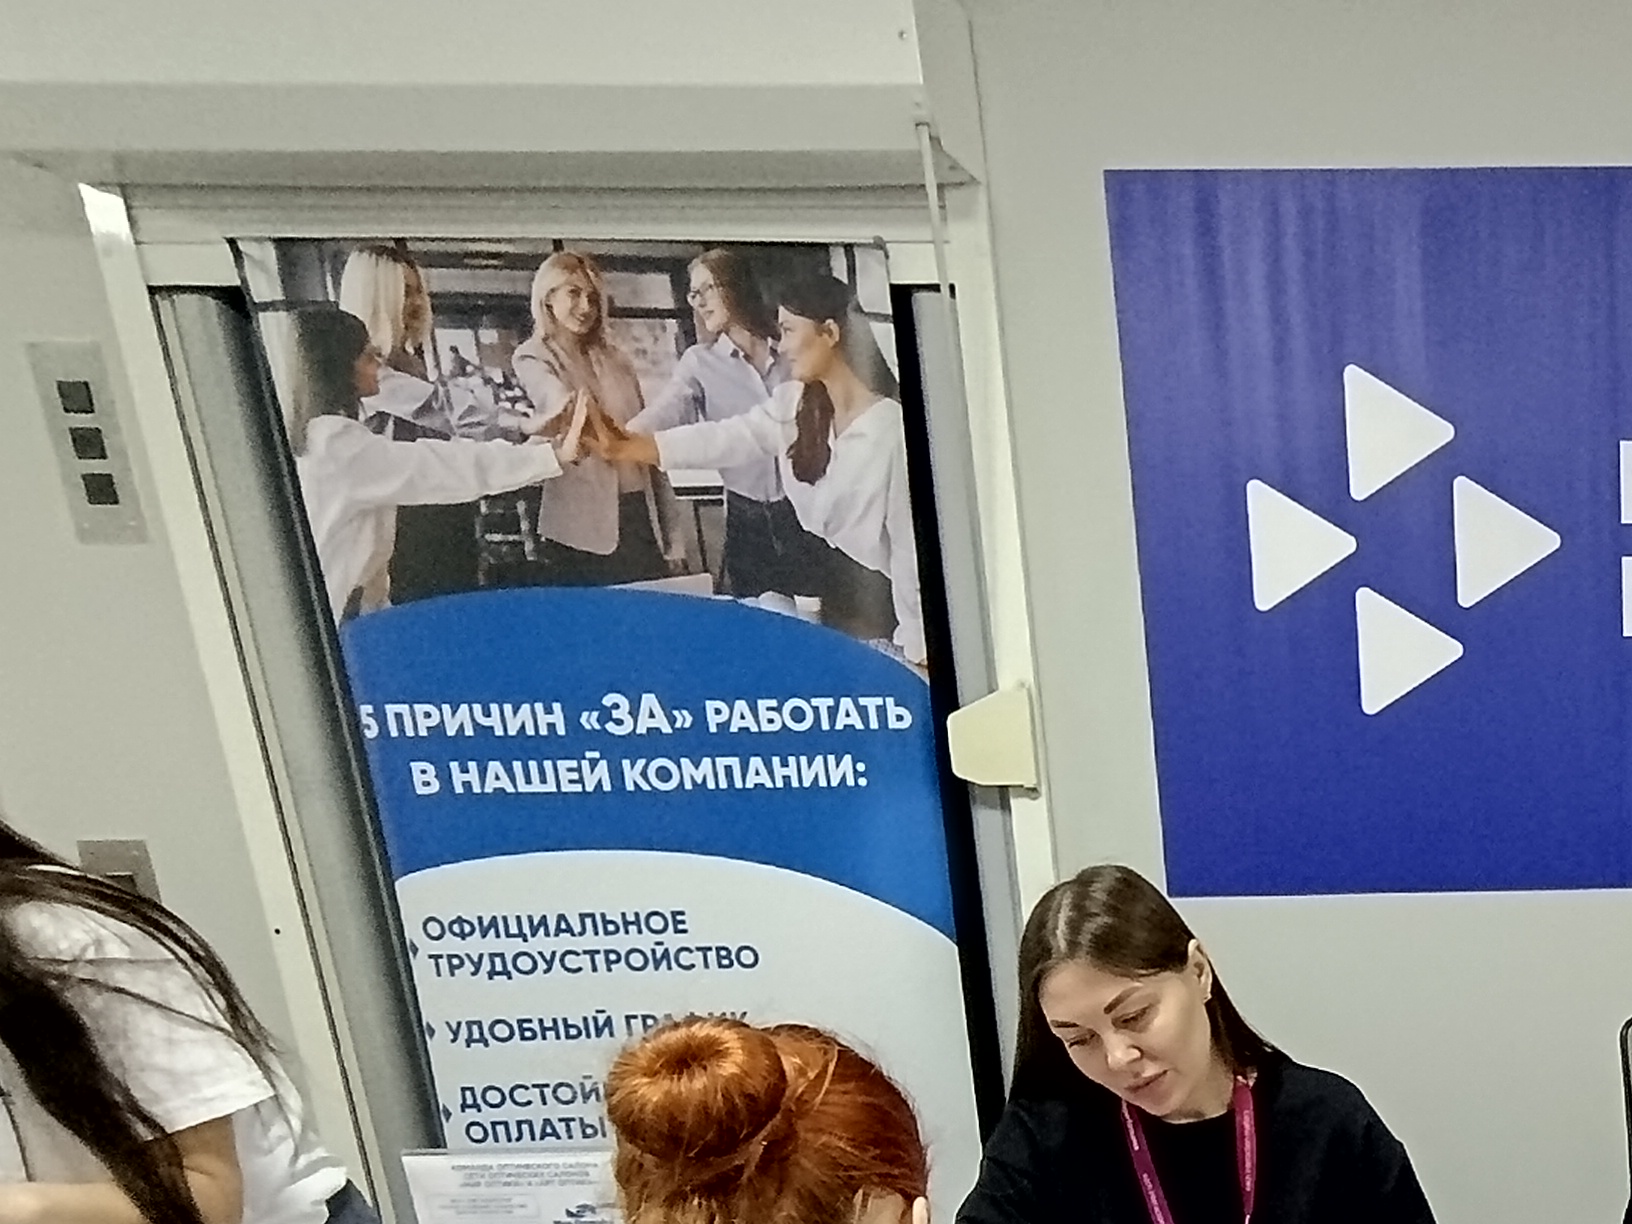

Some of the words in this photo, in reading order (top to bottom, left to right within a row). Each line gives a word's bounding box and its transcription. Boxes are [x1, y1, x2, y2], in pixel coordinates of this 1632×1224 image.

[387, 702, 565, 738] ПРИЧИН
[580, 692, 693, 735] «ЗА»
[706, 696, 913, 733] РАБОТАТЬ
[410, 760, 439, 796] В
[449, 751, 609, 794] НАШЕЙ
[622, 753, 868, 792] КОМПАНИИ:
[422, 910, 689, 942] ОФИЦИАЛЬНОЕ
[428, 941, 759, 980] ТРУДОУСТРОЙСТВО
[446, 1009, 615, 1048] УДОБНЫЙ
[460, 1075, 606, 1113] ДОСТОЙ
[465, 1116, 607, 1144] ОПЛАТЫ
